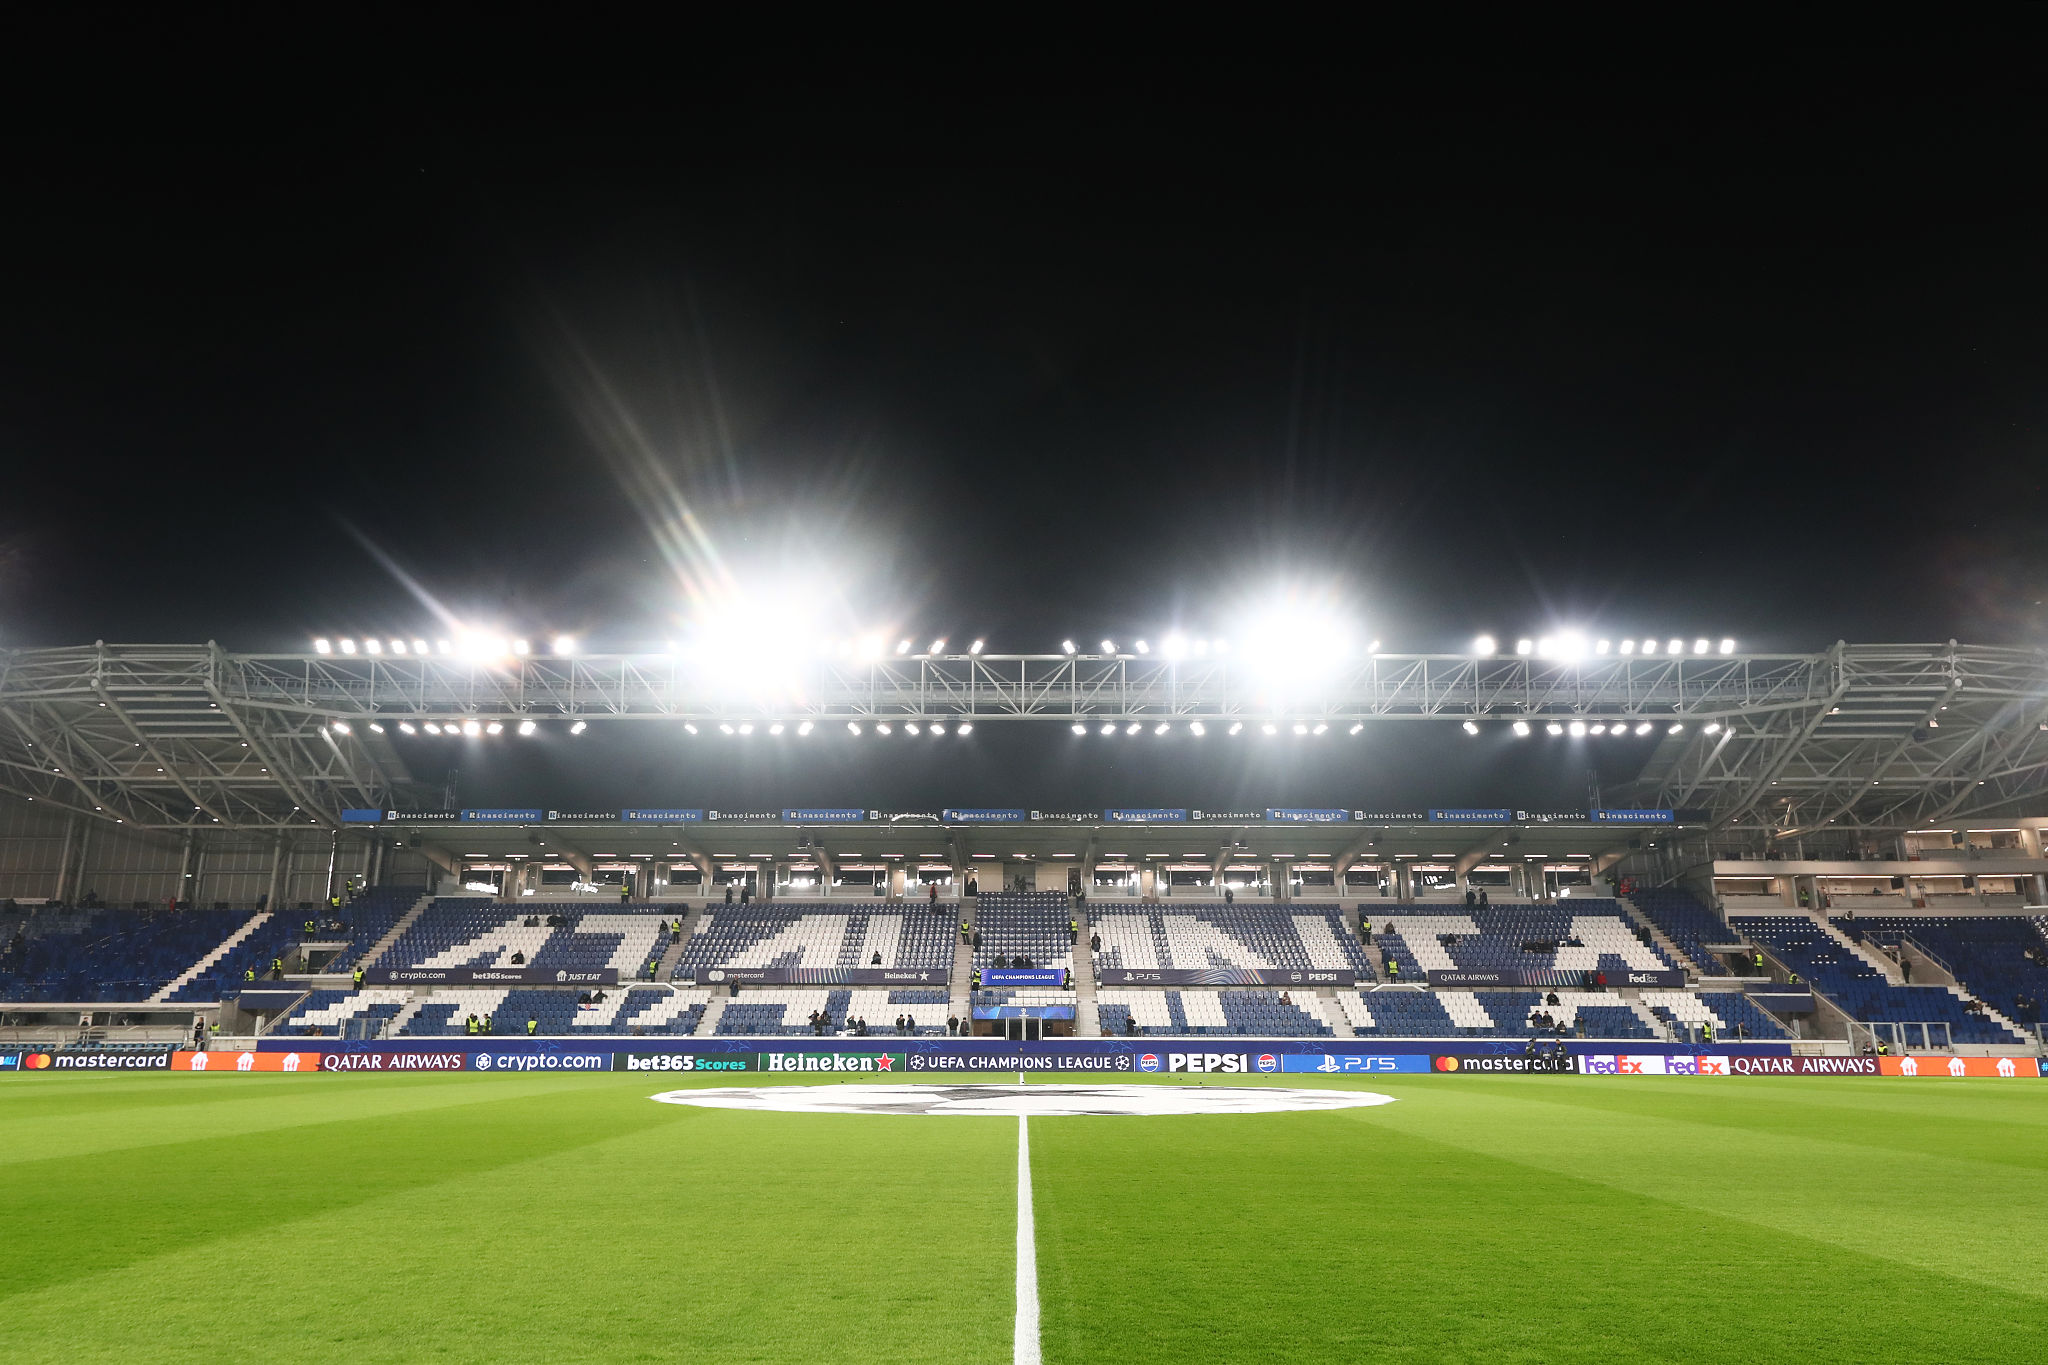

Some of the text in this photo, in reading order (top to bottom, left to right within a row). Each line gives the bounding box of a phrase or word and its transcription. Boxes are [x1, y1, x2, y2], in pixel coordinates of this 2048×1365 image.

[388, 811, 455, 820] Rinascimento
[470, 811, 535, 819] Rinascimento
[549, 811, 616, 820] Rinascimento
[630, 811, 696, 819] Rinascimento
[709, 811, 776, 820] Rinascimento
[790, 811, 857, 819] Rinascimento
[1031, 811, 1098, 820] Rinascimento
[1193, 811, 1260, 820] Rinascimento
[1355, 811, 1422, 820] Rinascimento
[1437, 811, 1504, 819] Rinascimento
[1600, 811, 1666, 819] Rinascimento
[400, 971, 446, 981] crypto.com
[567, 973, 602, 981] JUST EAT
[884, 972, 917, 980] Heineken
[1308, 973, 1337, 981] PEPSI
[1440, 974, 1466, 982] QATAR
[1628, 974, 1658, 983] FedEx
[55, 1053, 168, 1068] mastercard
[324, 1054, 461, 1070] QATAR AIRWAYS
[496, 1053, 602, 1071] crypto.com
[627, 1054, 694, 1071] bet365
[768, 1053, 873, 1072] Heineken
[928, 1056, 1111, 1069] UEFA CHAMPIONS LEAGUE
[1168, 1053, 1248, 1073] PEPSI
[1344, 1057, 1395, 1070] PS5
[1585, 1056, 1643, 1075] FedEx
[1665, 1056, 1723, 1075] FedEx
[1735, 1057, 1876, 1075] QATAR AIRWAYS
